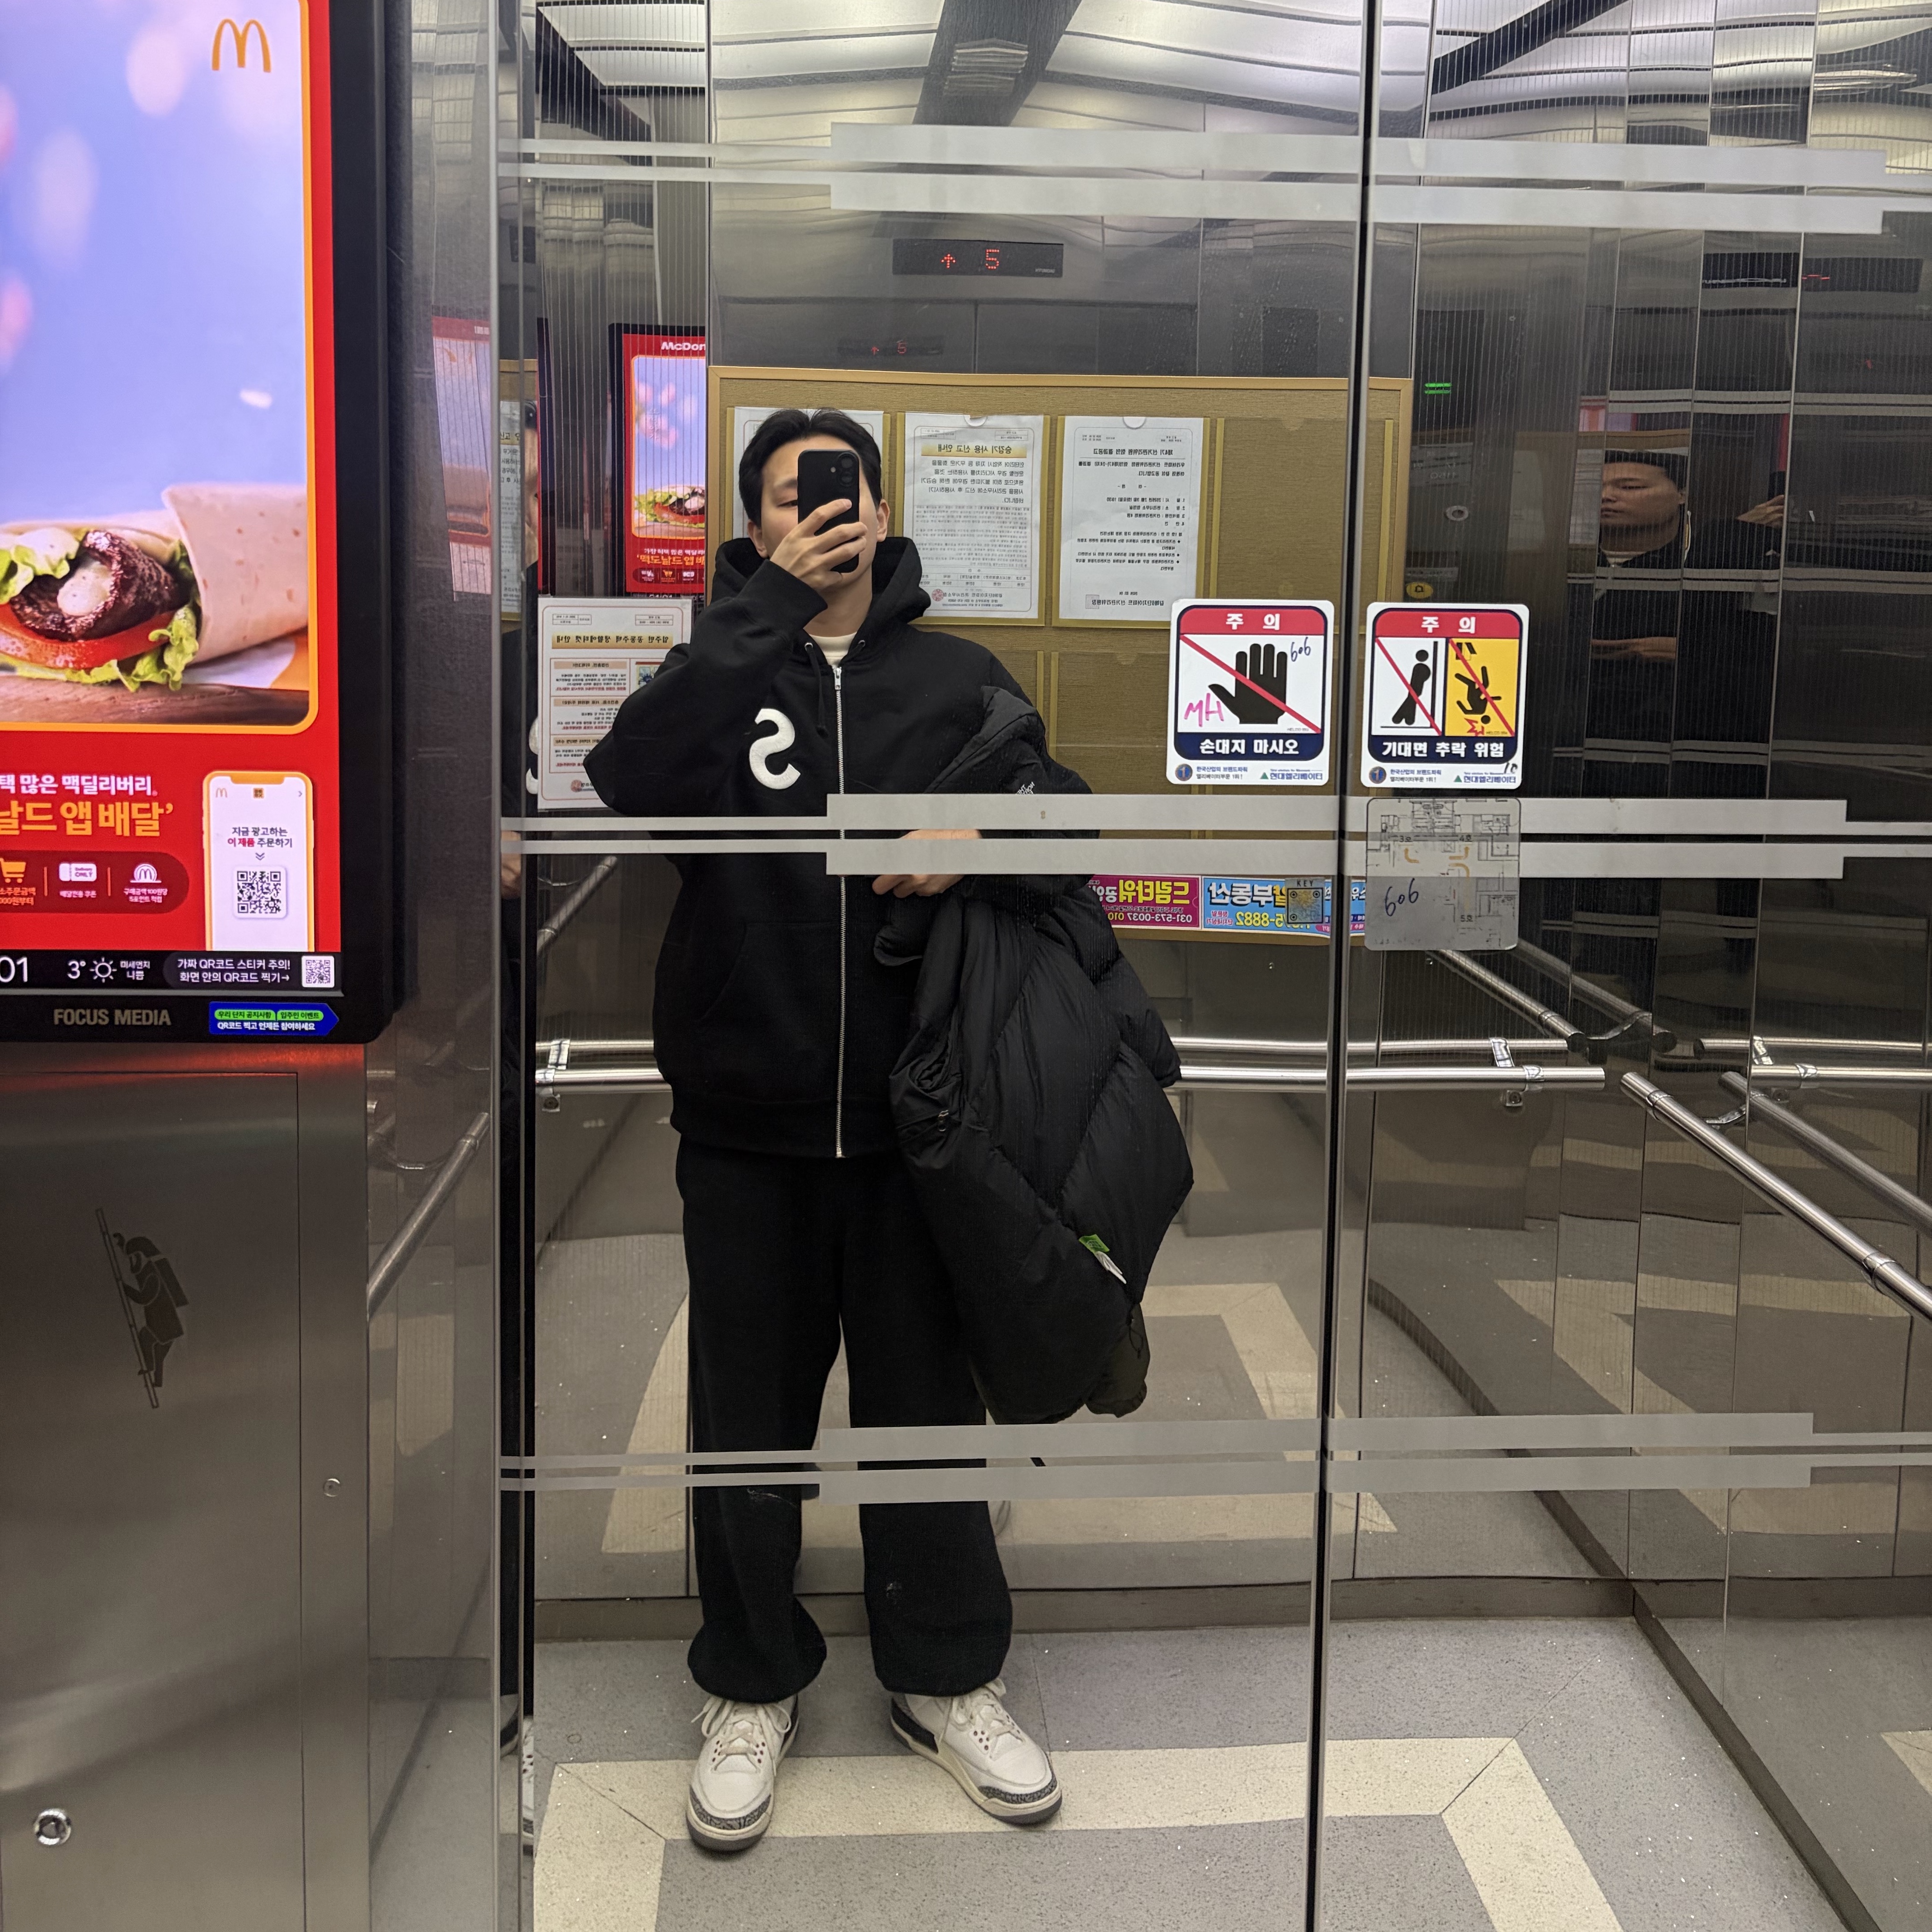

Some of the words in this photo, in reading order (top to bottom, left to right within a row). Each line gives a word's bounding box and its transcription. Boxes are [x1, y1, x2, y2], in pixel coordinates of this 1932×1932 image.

[985, 248, 1000, 270] 5
[683, 556, 694, 566] 앱
[1226, 613, 1244, 630] 주
[1263, 613, 1281, 630] 의
[1421, 616, 1439, 633] 주
[1458, 616, 1476, 634] 의
[1199, 739, 1246, 754] 손대지
[1253, 739, 1300, 754] 마시오
[1381, 741, 1428, 757] 기대면
[1435, 742, 1466, 758] 추락
[1474, 742, 1504, 758] 위험
[19, 774, 59, 795] 많은
[61, 775, 158, 797] 맥딜리버리.
[1463, 775, 1516, 784] 현대엘리베이터
[60, 801, 92, 836] 앱
[232, 827, 249, 836] 지금
[251, 827, 288, 837] 광고하는
[227, 837, 236, 847] 이
[238, 838, 255, 848] 제품
[257, 838, 293, 848] 주문하기
[1384, 878, 1419, 916] 606
[120, 960, 150, 969] 미세먼지
[177, 959, 197, 969] 가짜
[198, 959, 235, 970] QR코드
[237, 959, 266, 970] 스티커
[268, 959, 290, 970] 주의!
[126, 970, 144, 980] 나쁨
[180, 972, 200, 983] 화면
[202, 972, 221, 983] 안의
[223, 973, 259, 983] QR코드
[261, 973, 281, 983] 찍기
[54, 1008, 110, 1026] FOCUS
[114, 1009, 172, 1026] MEDIA
